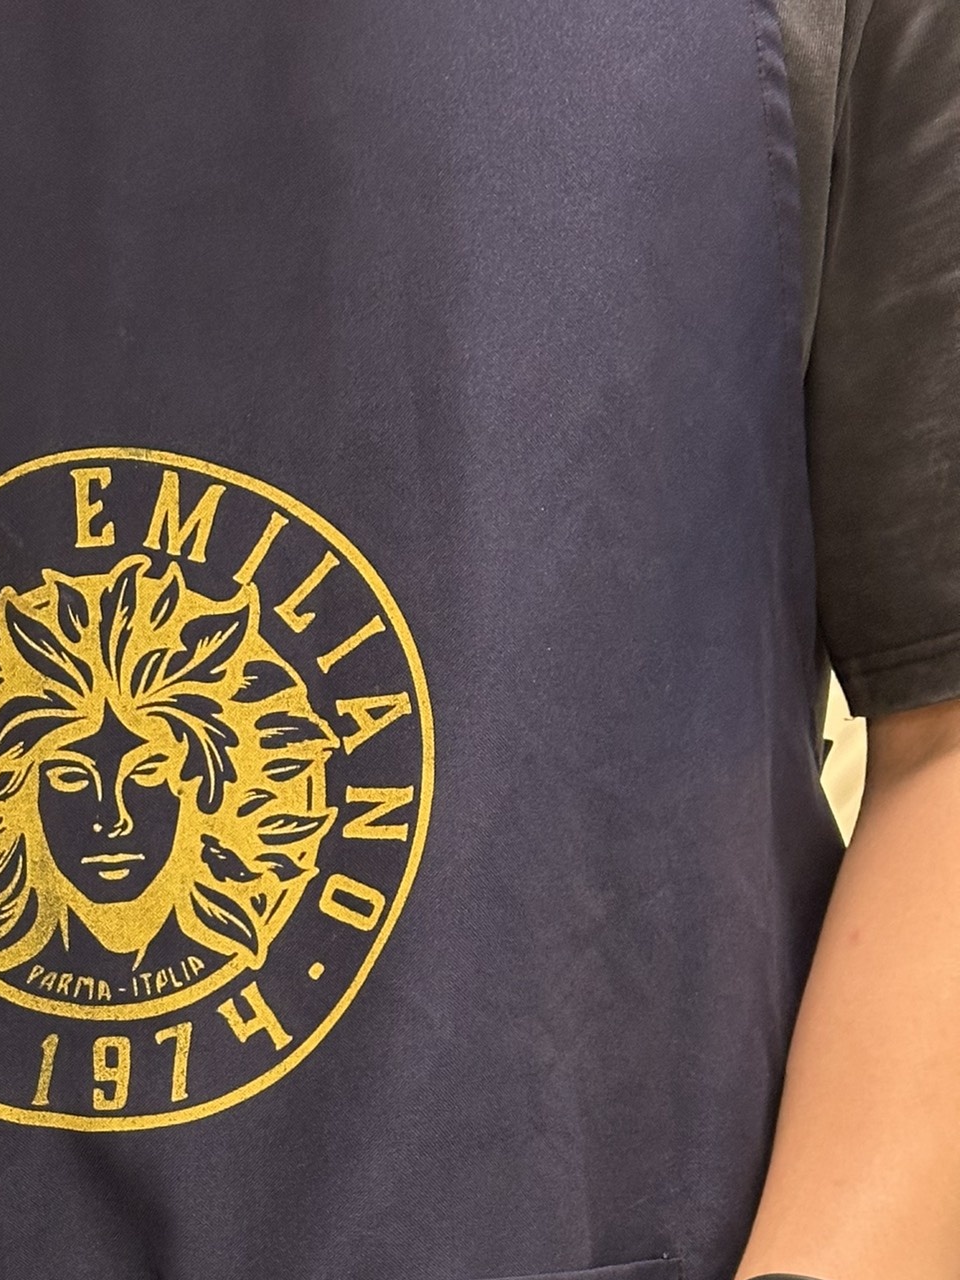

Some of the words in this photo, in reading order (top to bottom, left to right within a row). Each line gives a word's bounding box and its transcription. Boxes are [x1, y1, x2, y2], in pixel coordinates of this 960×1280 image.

[69, 466, 416, 932] EMILIANO
[26, 964, 112, 1001] PARMA
[131, 955, 206, 997] ITALIA
[31, 981, 294, 1111] 1974
